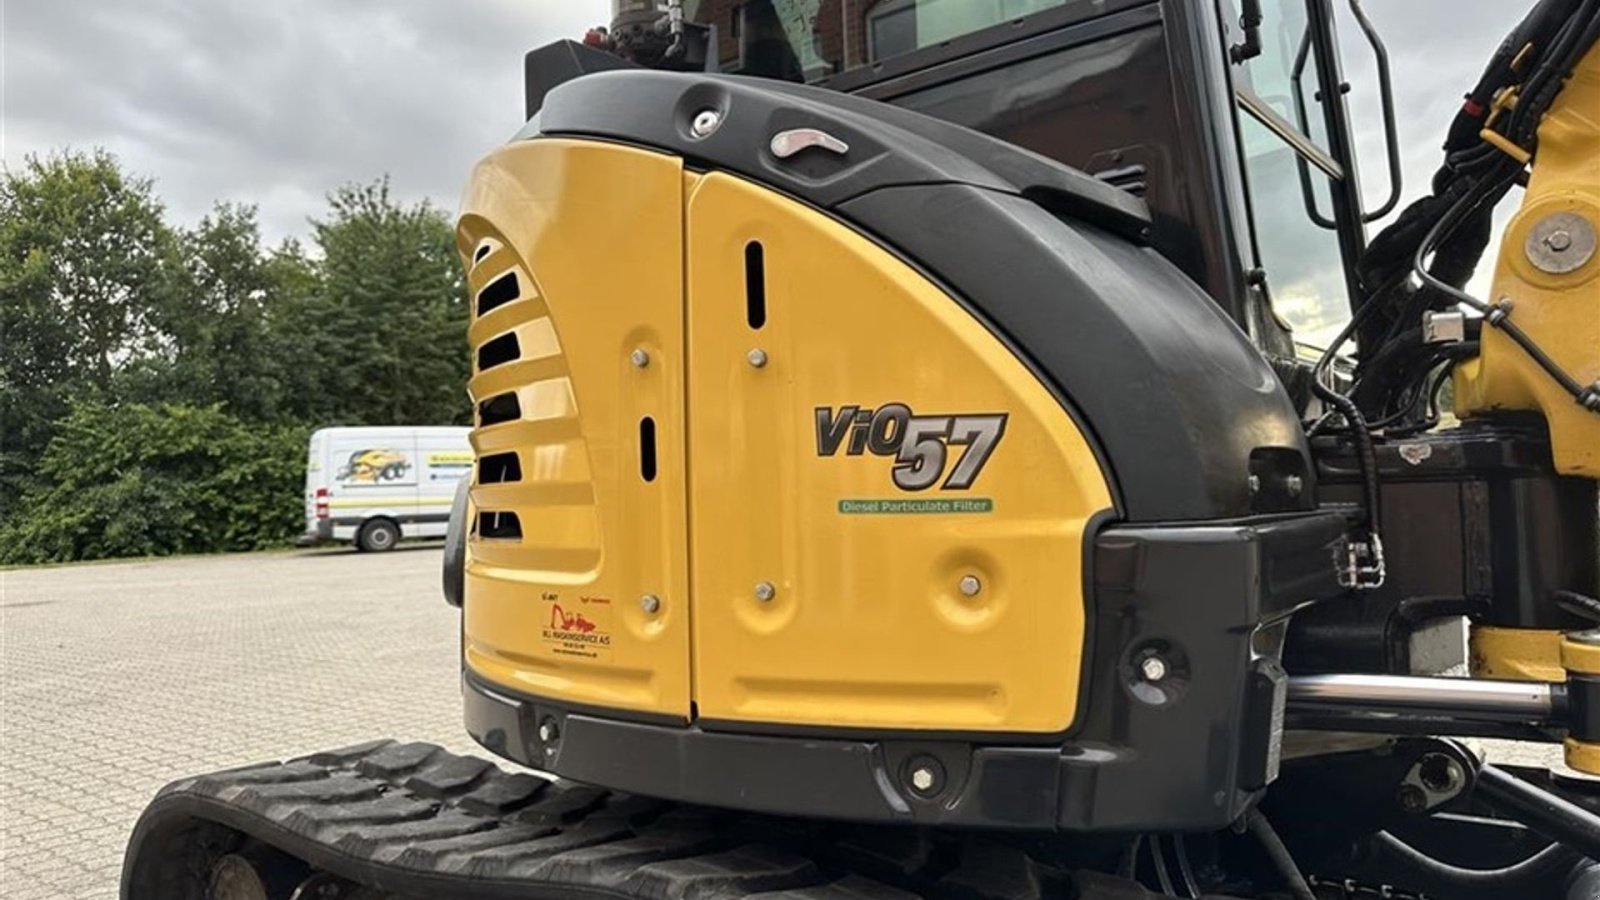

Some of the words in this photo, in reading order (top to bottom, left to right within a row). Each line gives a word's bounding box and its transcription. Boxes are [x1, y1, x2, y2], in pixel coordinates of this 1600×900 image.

[842, 501, 878, 511] Diesel
[882, 501, 950, 511] Particulate
[953, 500, 988, 511] Filter
